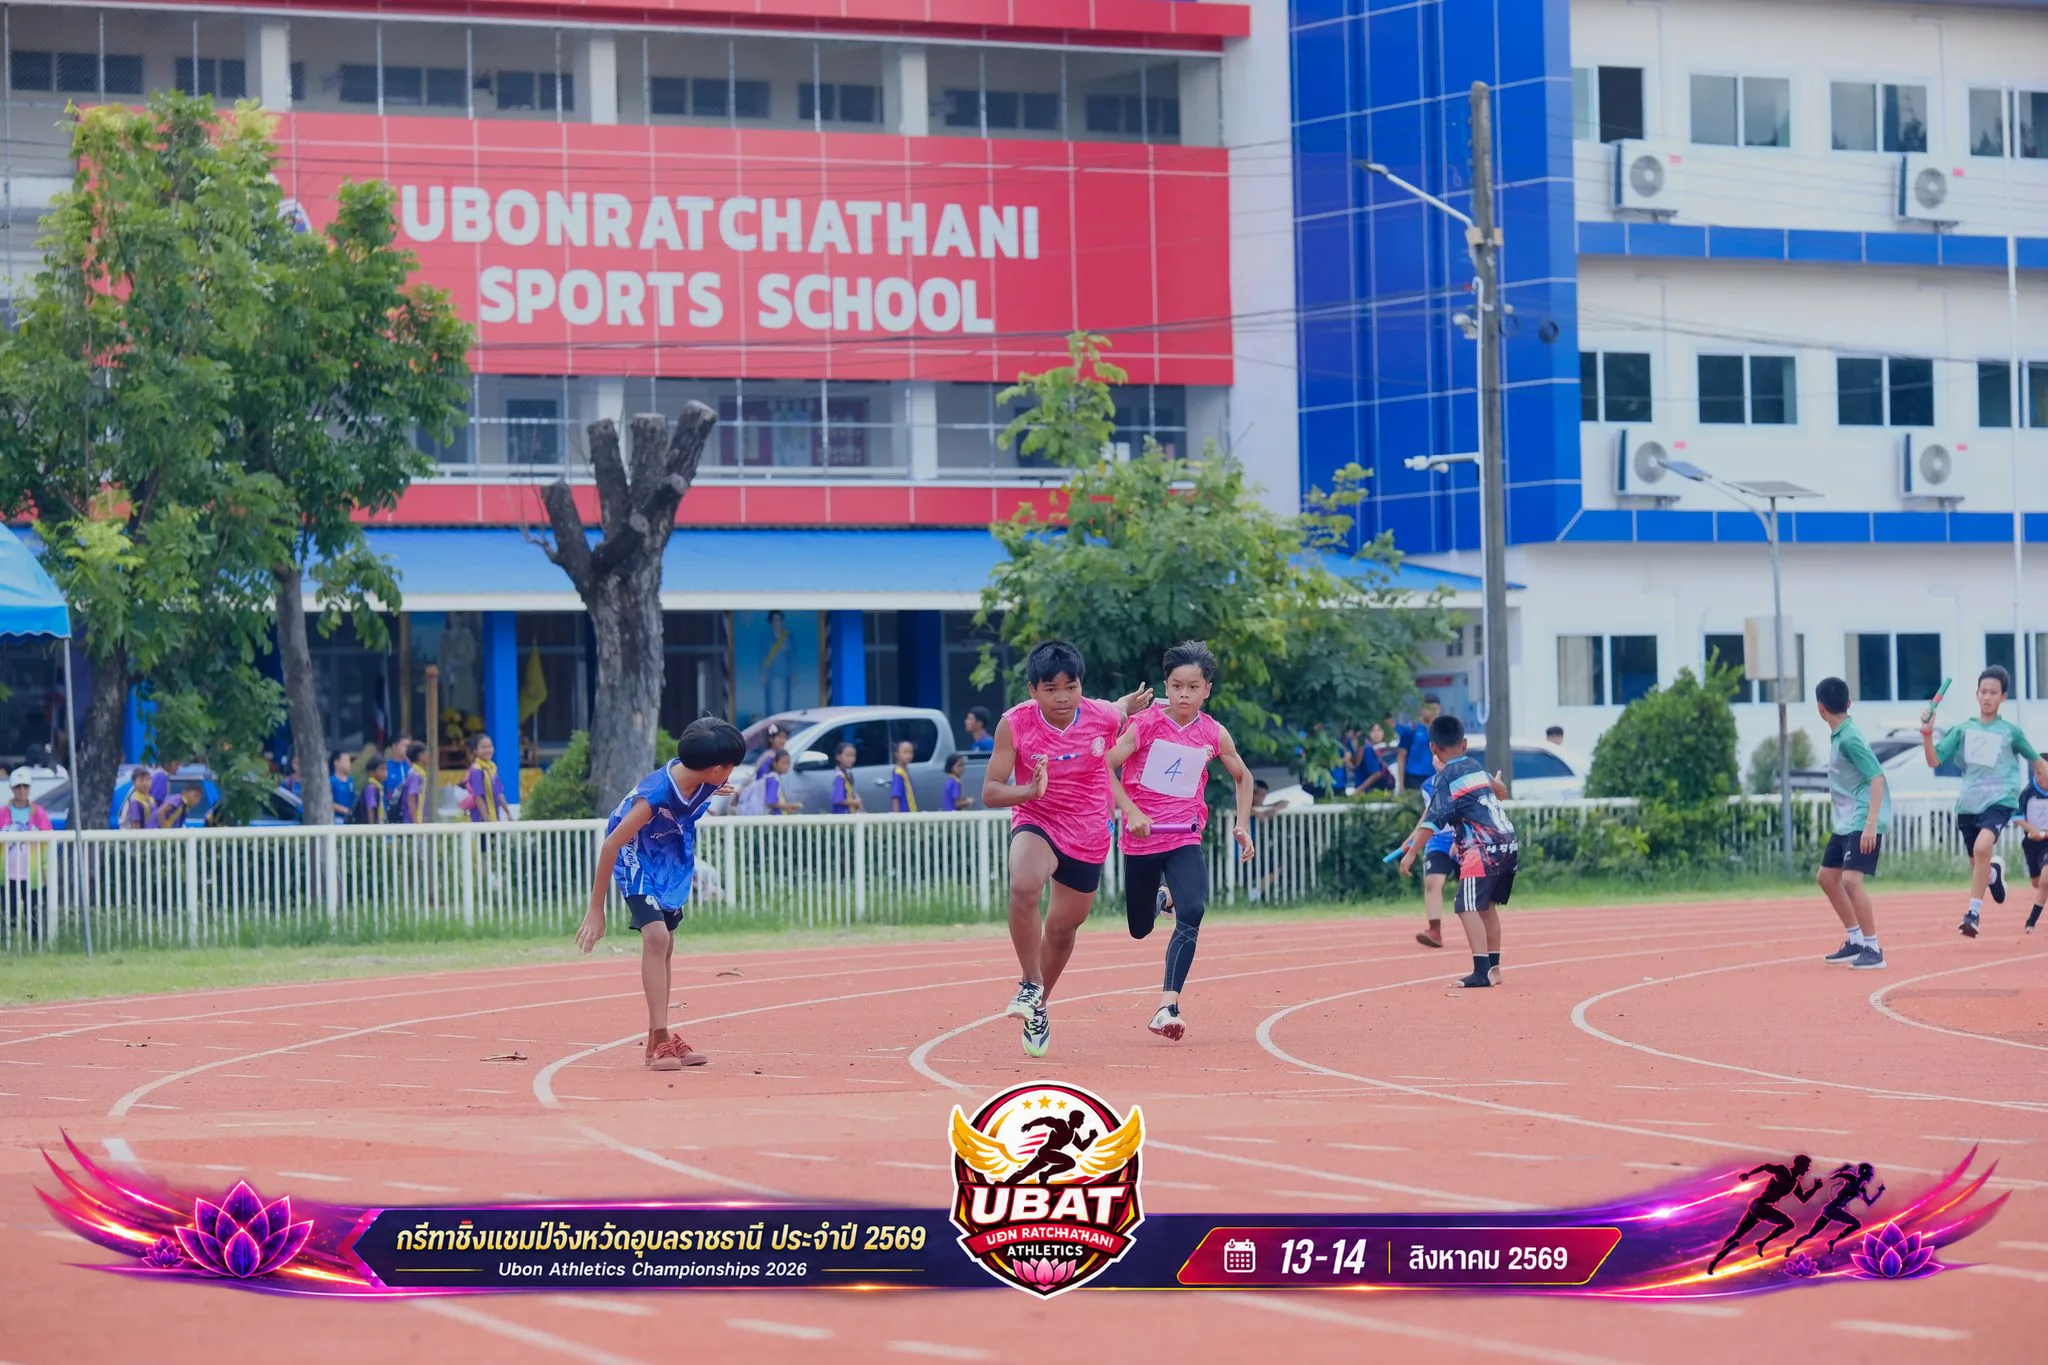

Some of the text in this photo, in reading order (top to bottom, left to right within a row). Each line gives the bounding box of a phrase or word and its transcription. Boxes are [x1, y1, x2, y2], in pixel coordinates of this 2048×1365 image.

[401, 185, 1040, 260] UBONRATCHATHANI
[479, 266, 995, 334] SPORTS SCHOOL
[1164, 757, 1183, 783] 4
[1971, 736, 1988, 759] 2
